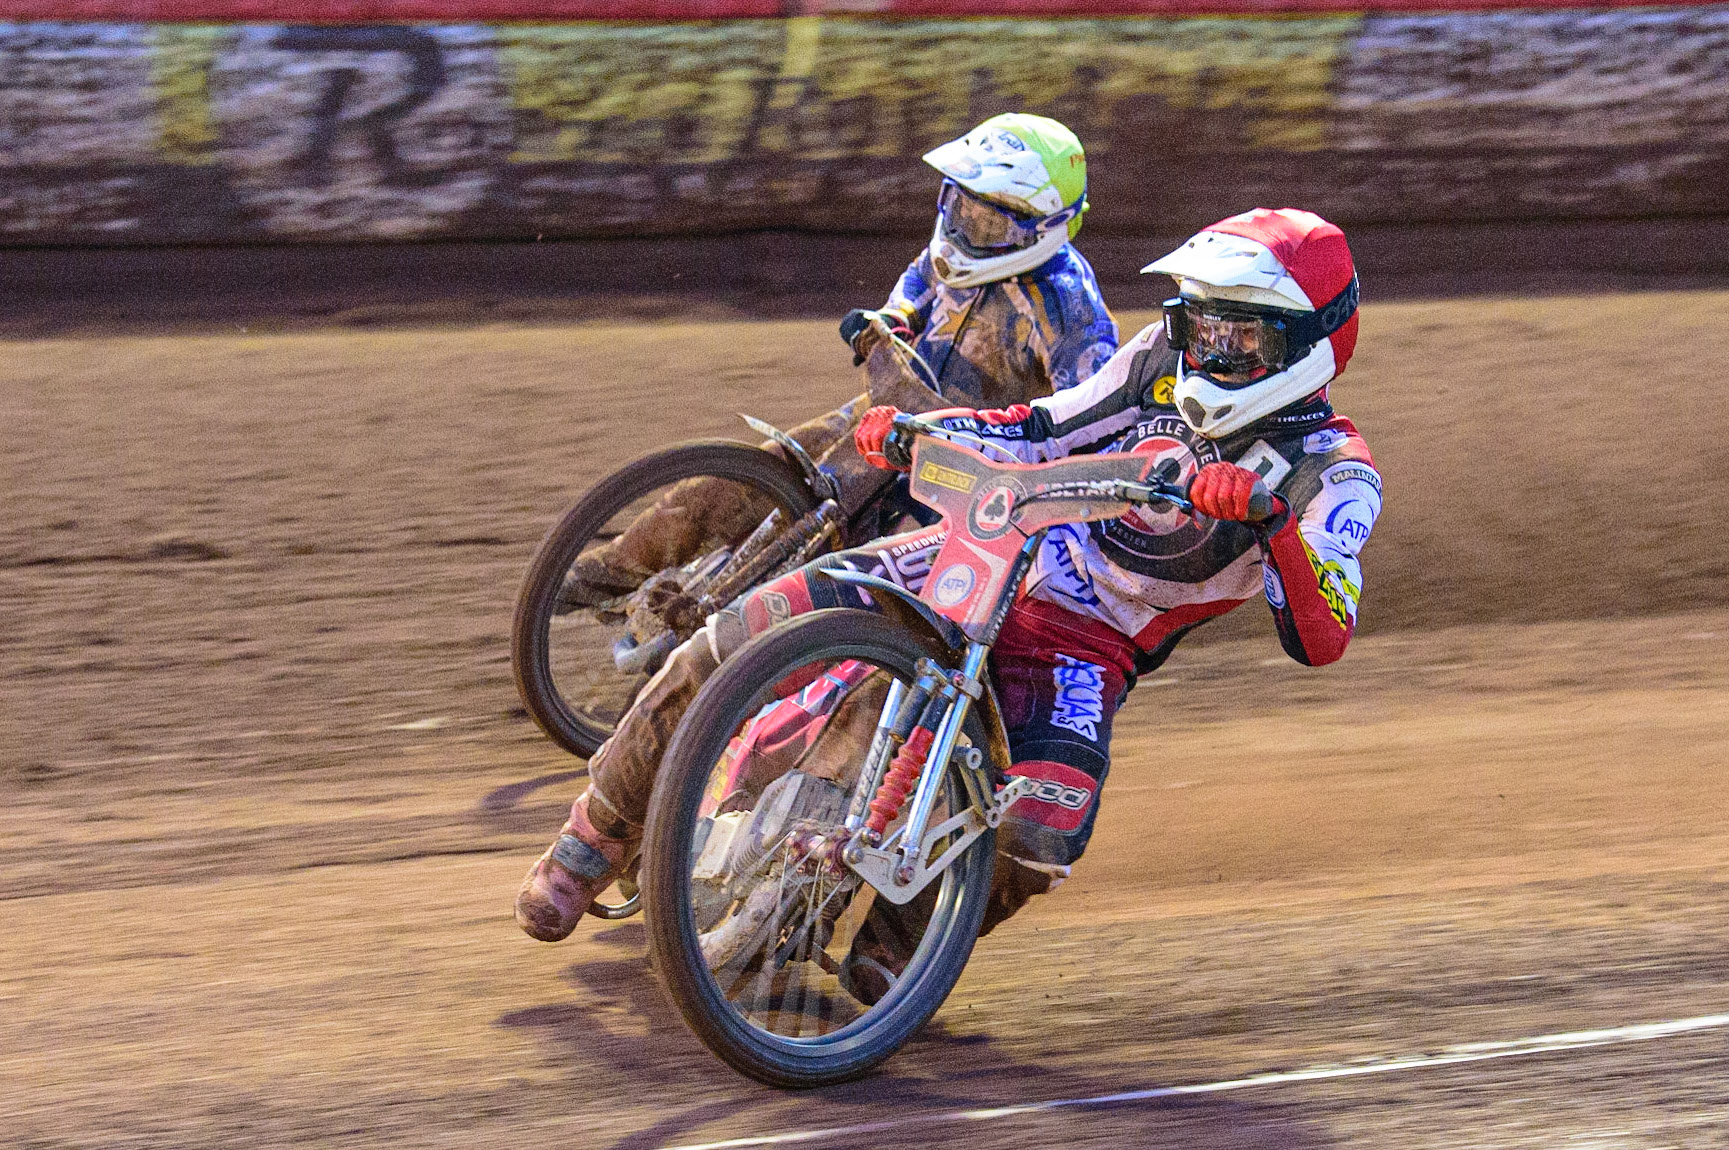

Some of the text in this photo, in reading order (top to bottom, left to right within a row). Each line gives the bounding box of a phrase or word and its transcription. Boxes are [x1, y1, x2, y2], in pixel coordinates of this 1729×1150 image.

[1137, 420, 1215, 465] BELLE VUE
[1338, 517, 1370, 543] ATP
